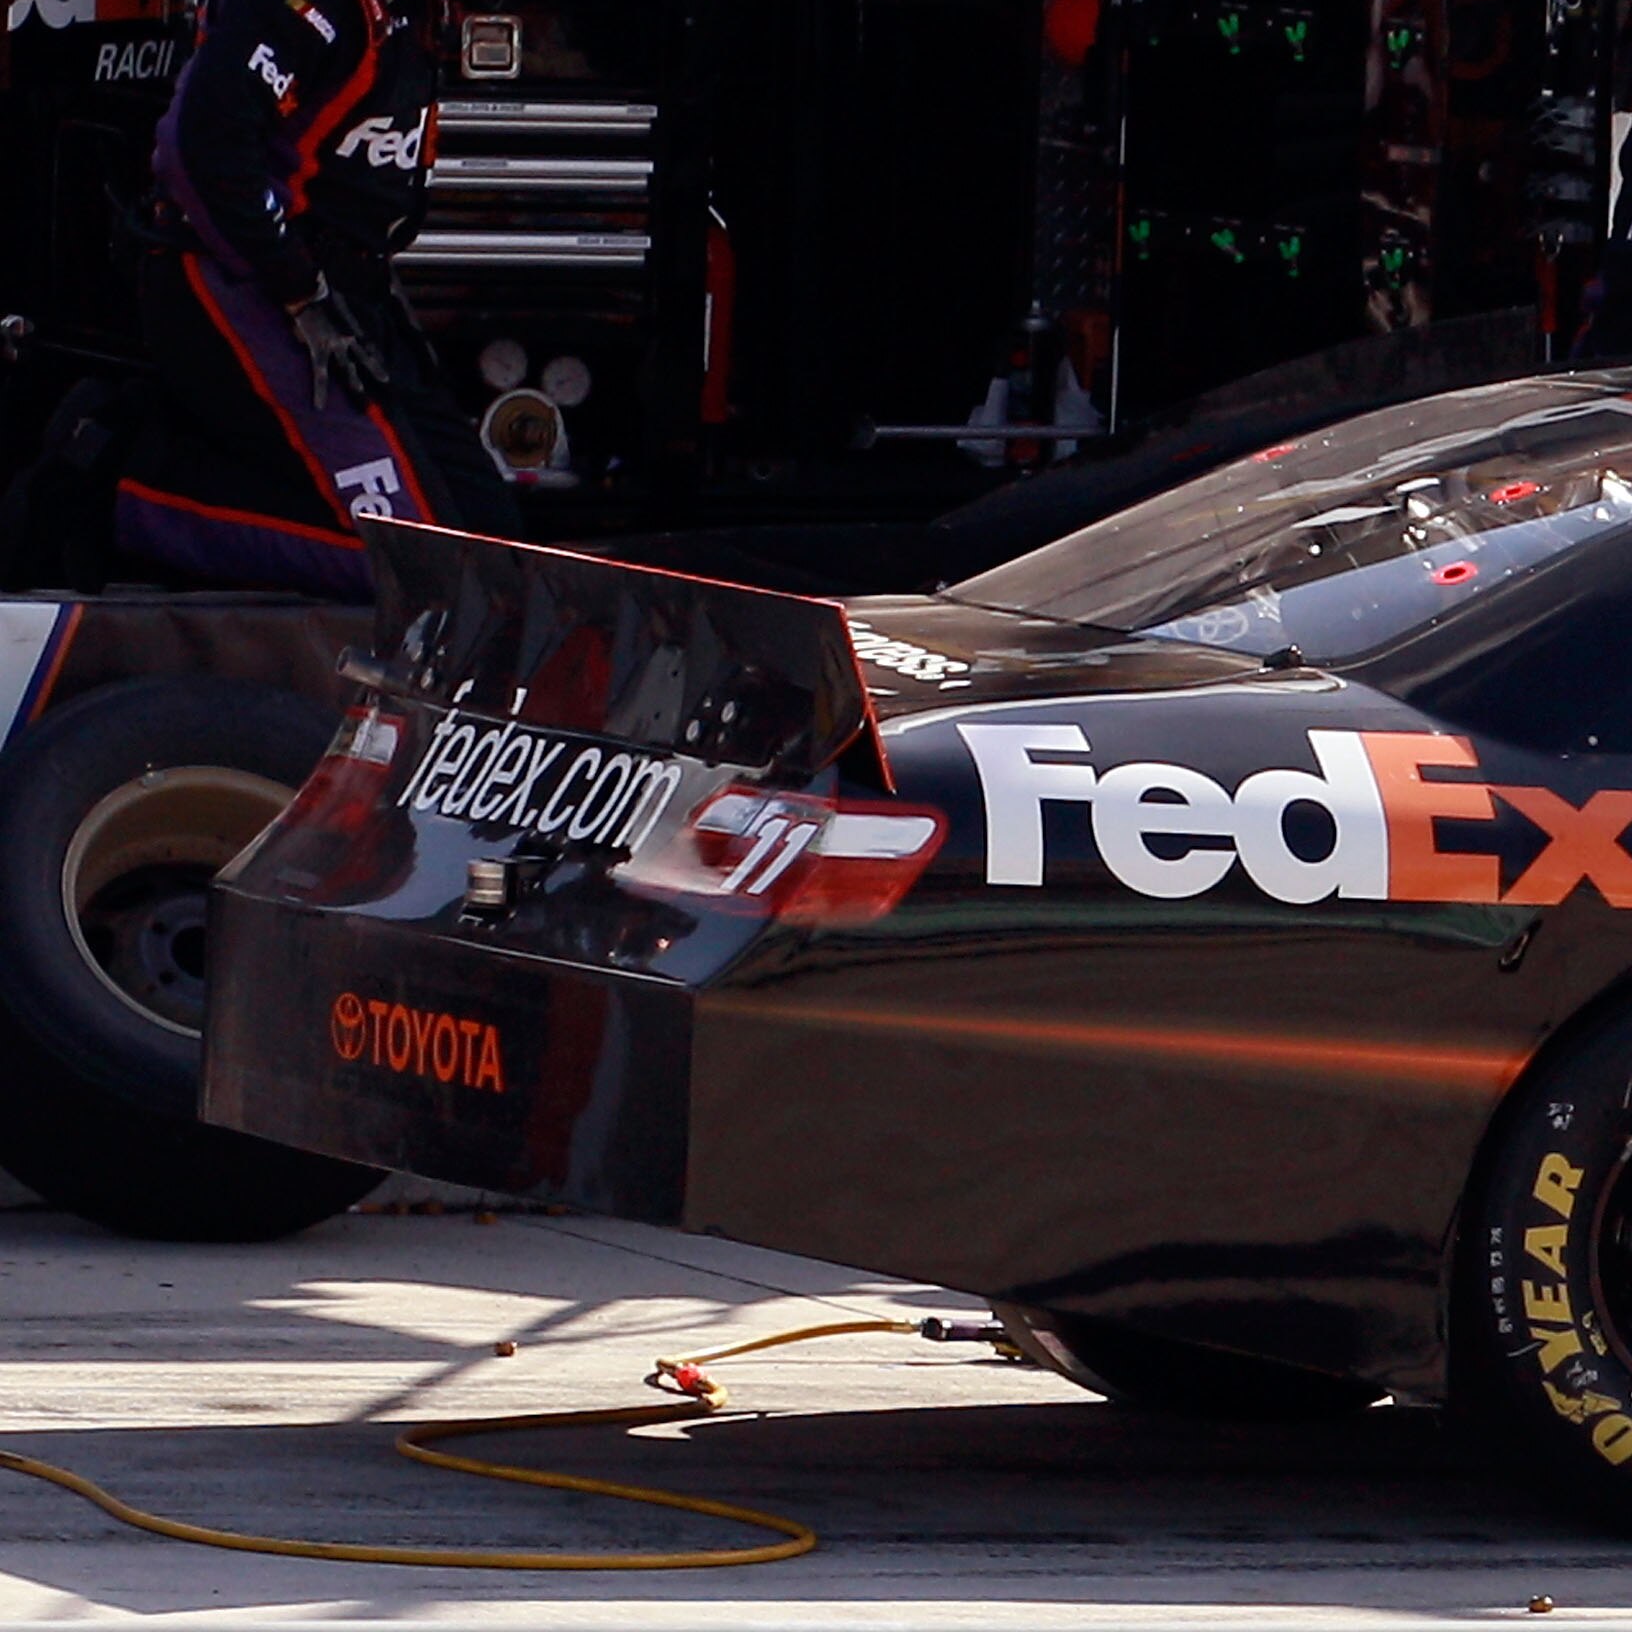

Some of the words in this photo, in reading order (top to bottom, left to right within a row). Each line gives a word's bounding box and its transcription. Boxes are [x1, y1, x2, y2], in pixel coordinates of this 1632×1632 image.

[336, 100, 438, 169] Fed
[397, 680, 682, 849] fedex.com
[367, 997, 505, 1094] TOYOTA
